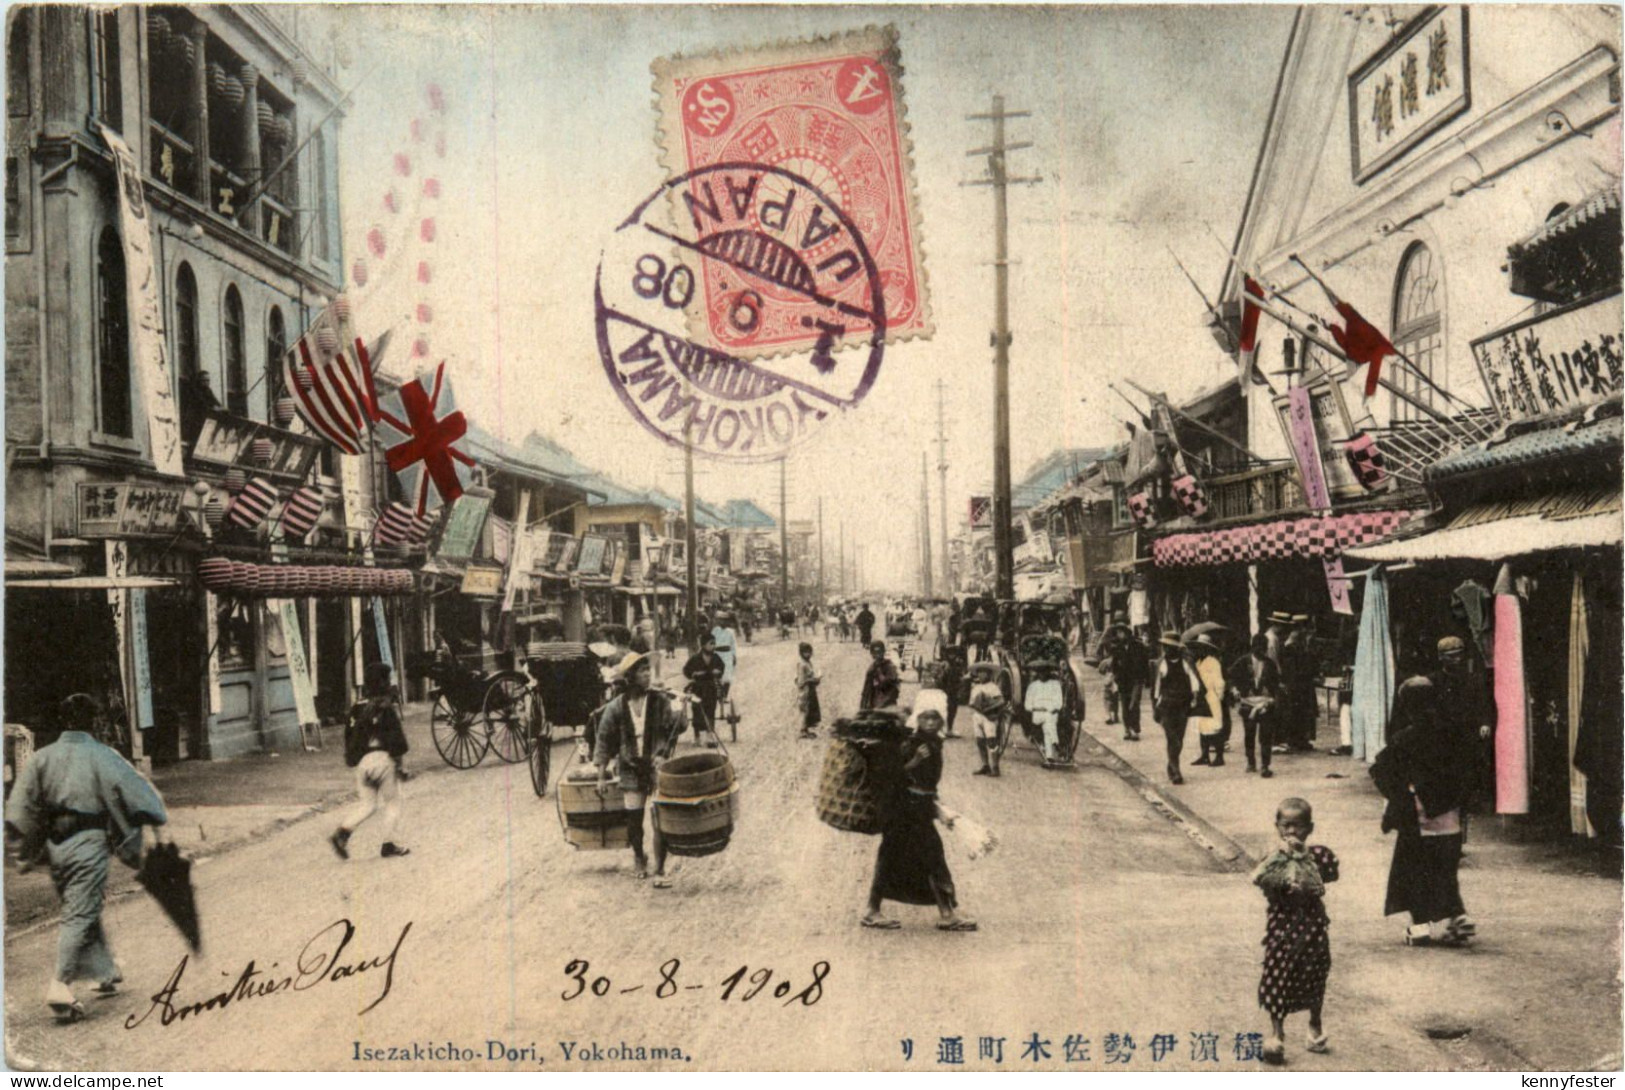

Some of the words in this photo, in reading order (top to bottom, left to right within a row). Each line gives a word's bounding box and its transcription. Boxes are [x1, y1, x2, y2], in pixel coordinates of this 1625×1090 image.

[846, 65, 884, 104] 4
[682, 175, 862, 282] JAPAN
[618, 330, 828, 452] YOKOHAMA
